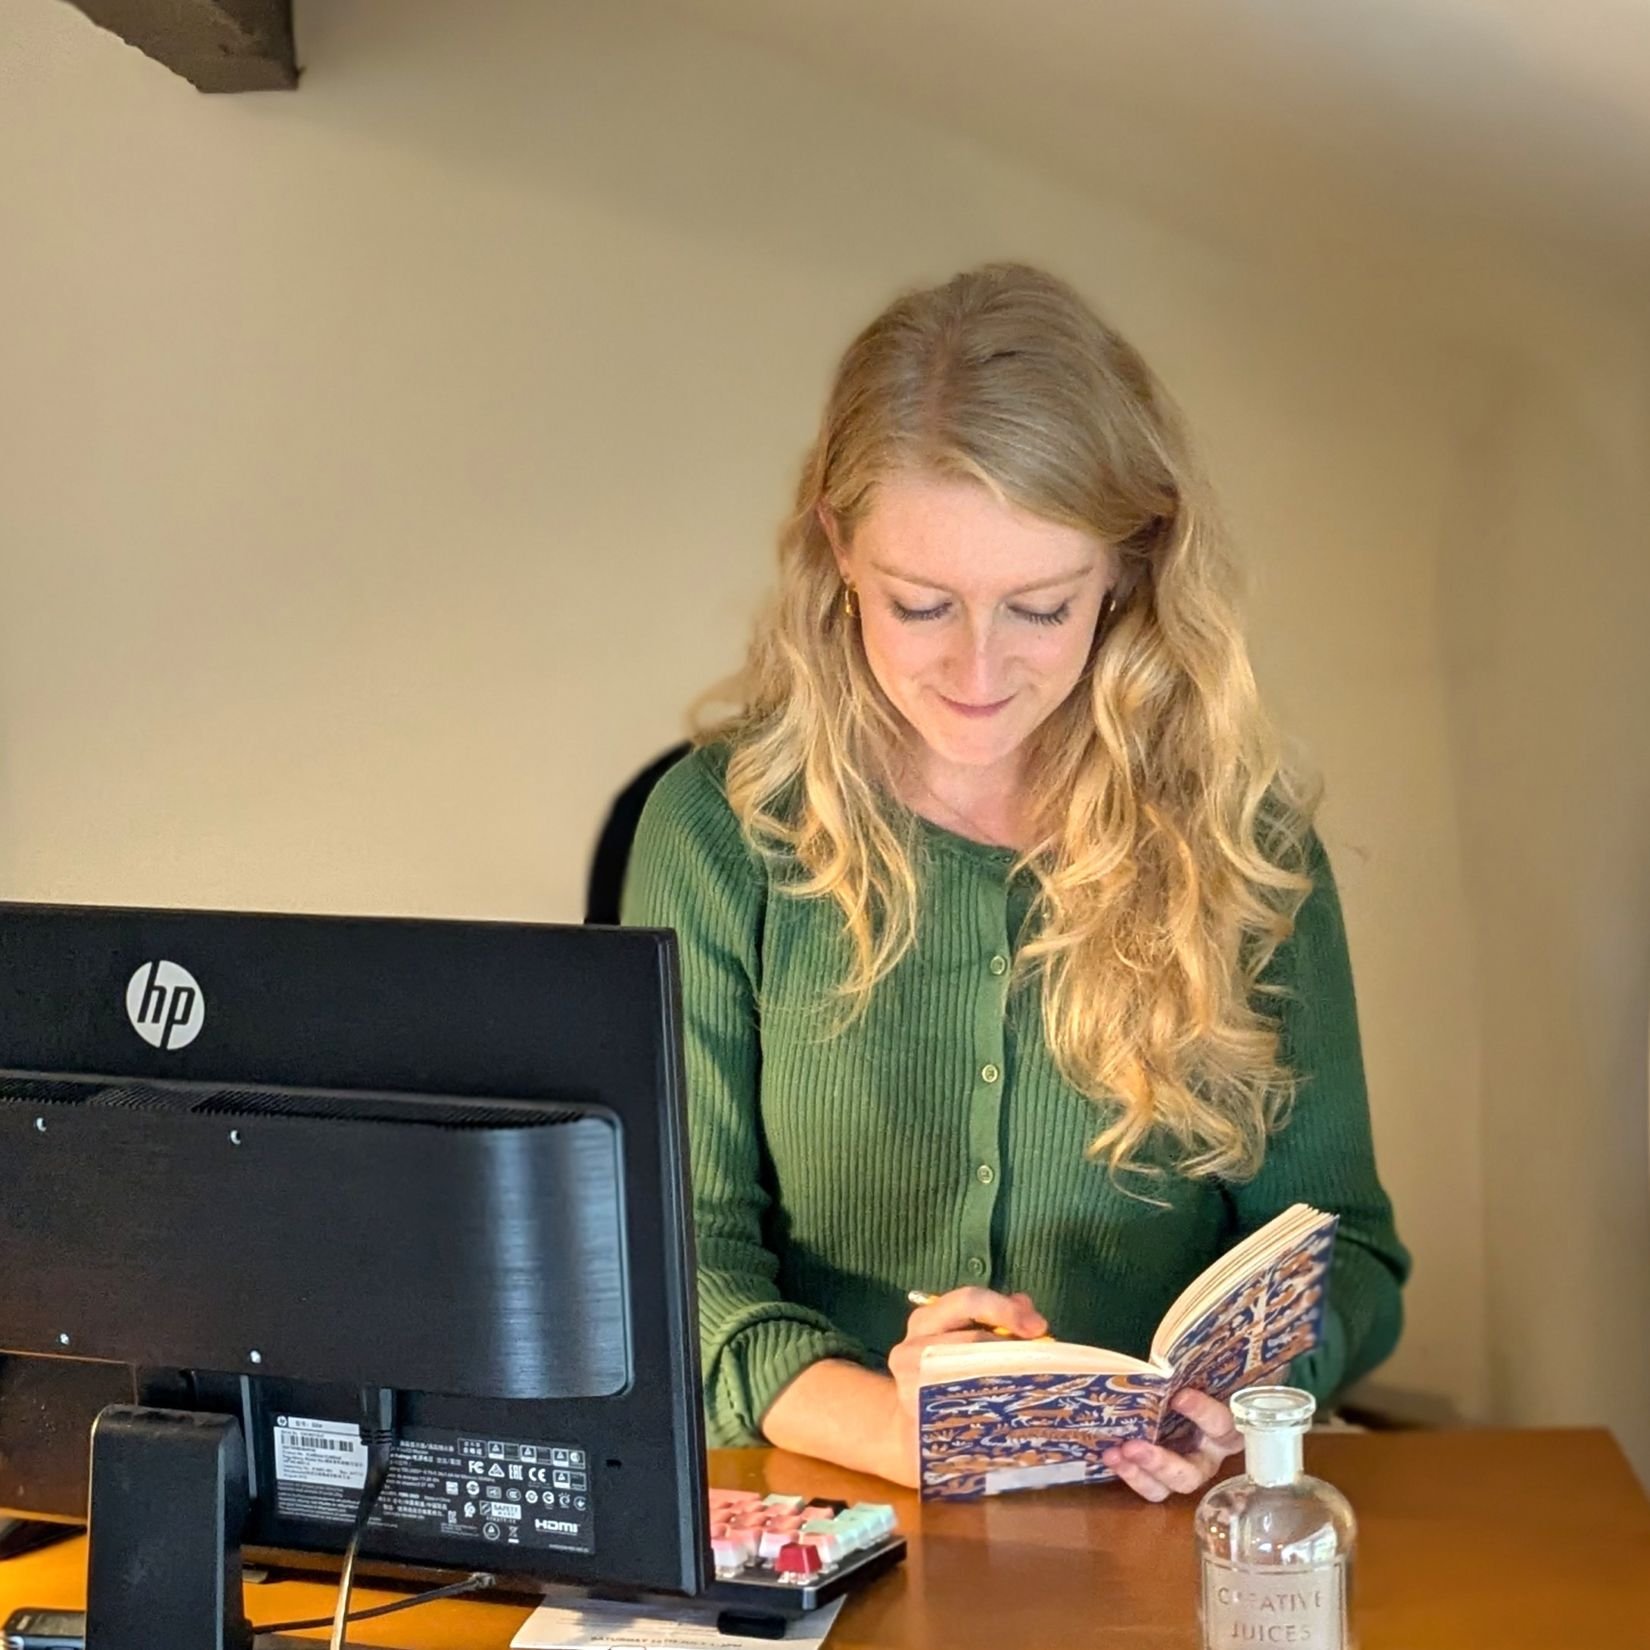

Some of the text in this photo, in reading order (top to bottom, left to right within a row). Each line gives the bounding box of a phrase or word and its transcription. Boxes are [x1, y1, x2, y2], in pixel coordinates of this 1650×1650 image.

[132, 960, 200, 1050] hp
[535, 1519, 578, 1533] HDMI
[1217, 1587, 1321, 1612] CATIVE
[1231, 1621, 1311, 1642] JUICES
